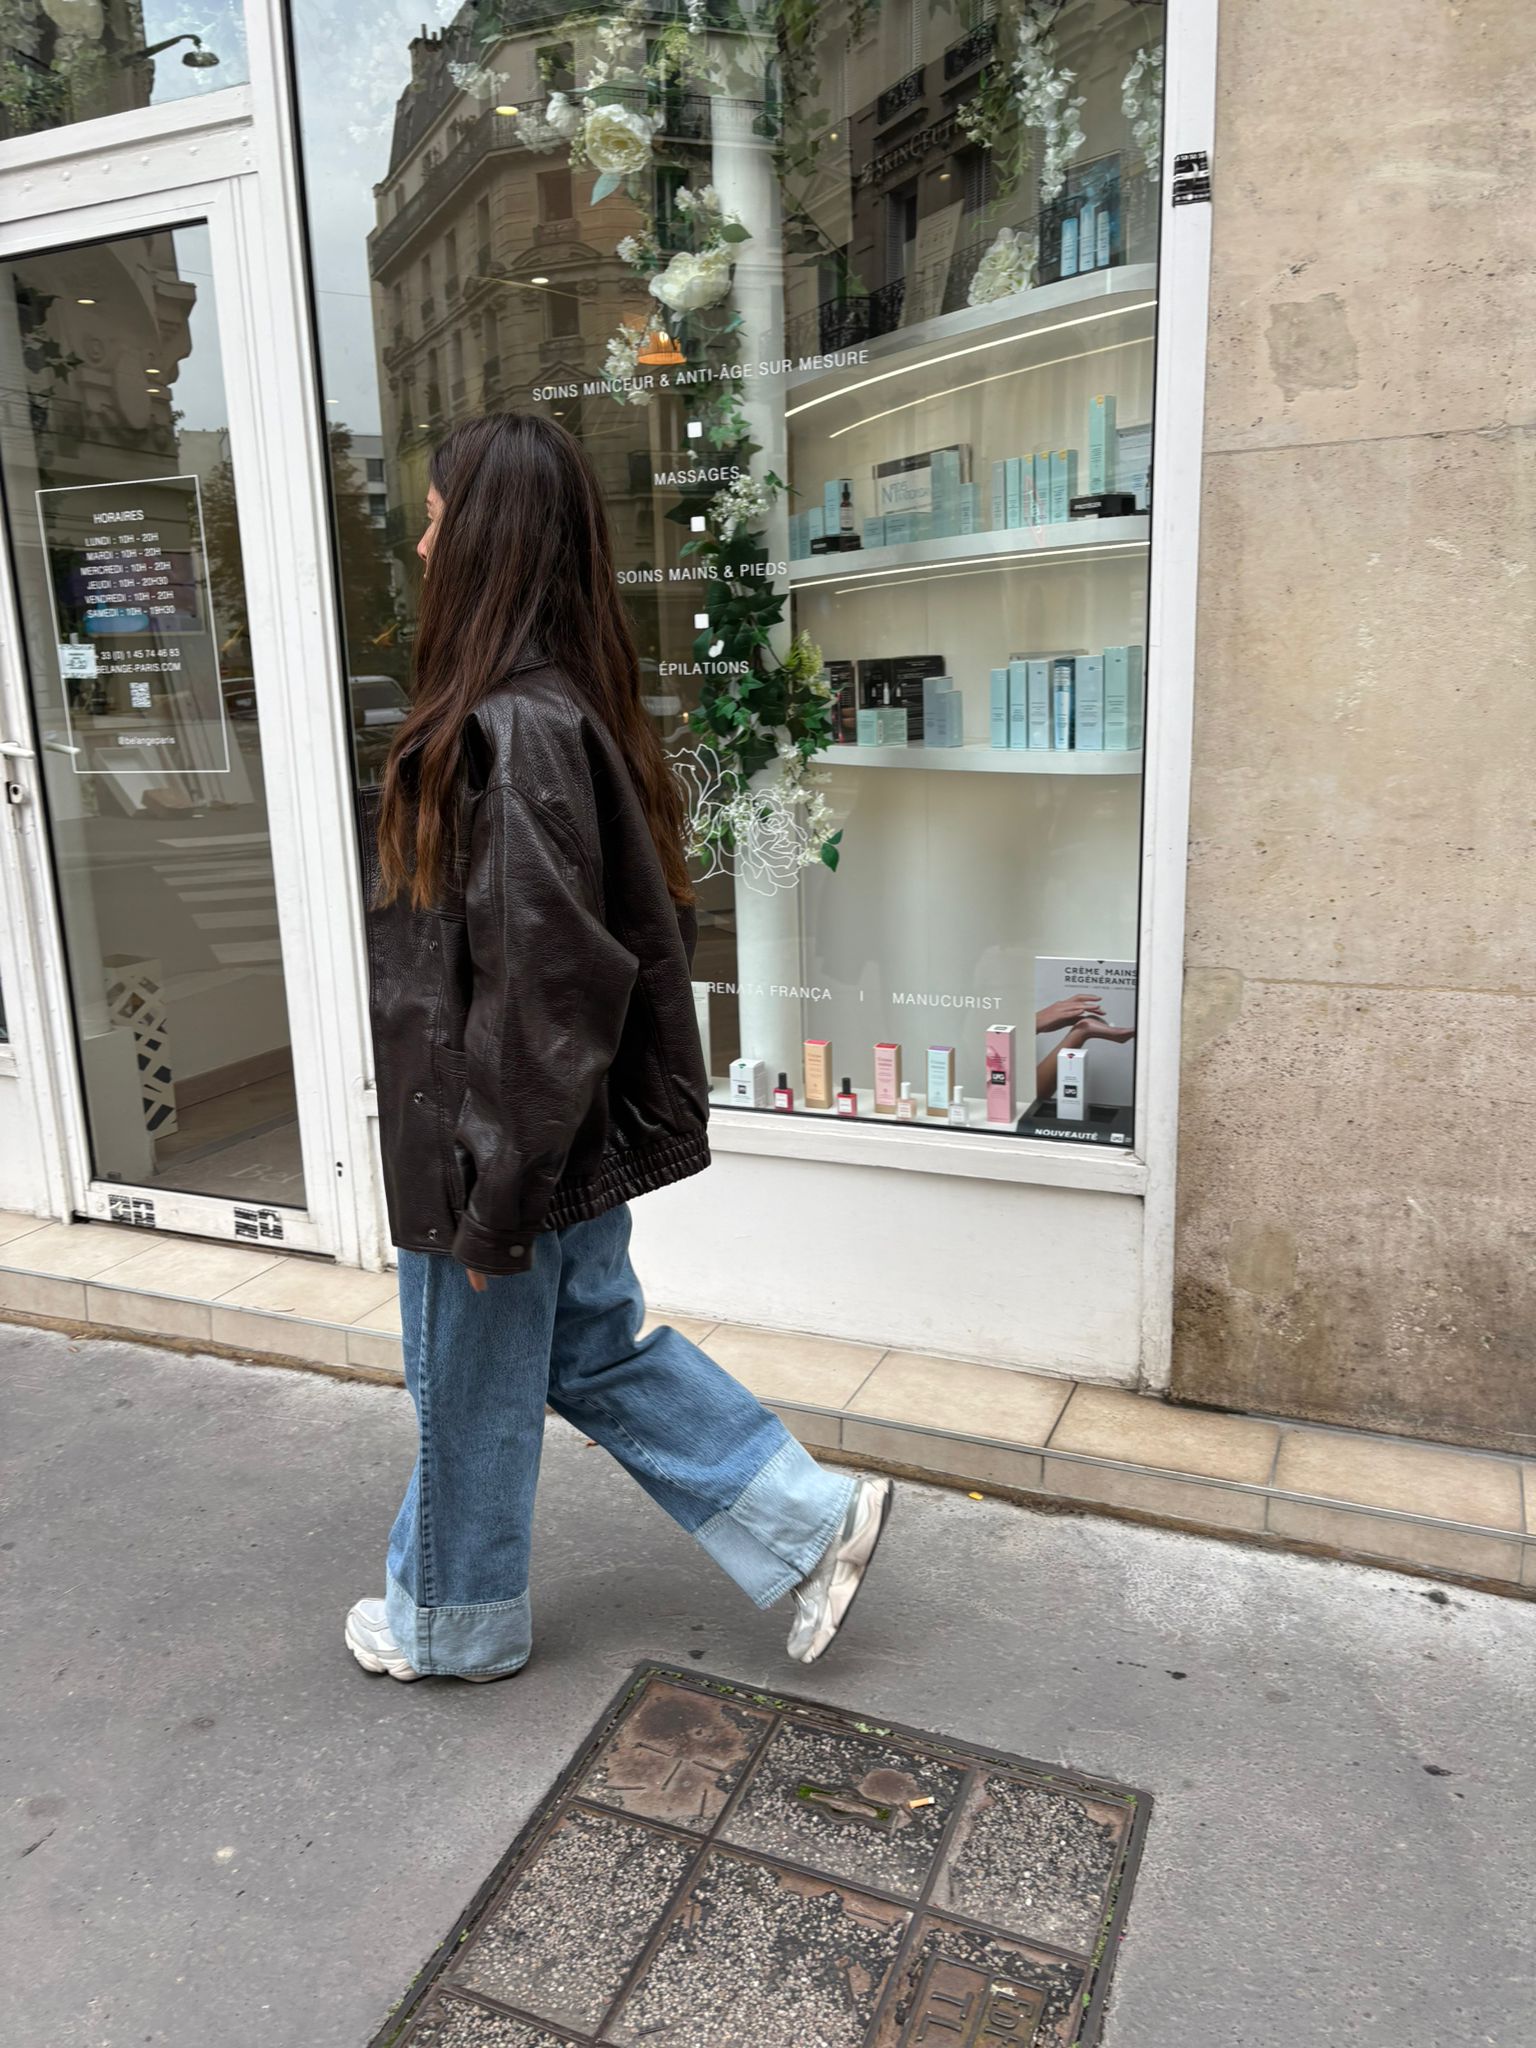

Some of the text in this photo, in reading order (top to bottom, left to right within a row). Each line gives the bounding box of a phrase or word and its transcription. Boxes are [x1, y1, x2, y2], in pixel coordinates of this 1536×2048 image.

[532, 349, 869, 401] SOINS MINCEUR & ANTI-ÂGE SUR MESURE
[654, 465, 741, 486] MASSAGES
[93, 509, 145, 524] HORAIRES
[84, 536, 111, 547] LUNDI
[86, 550, 114, 561] MARDI
[80, 564, 123, 576] MERCREDI
[616, 561, 788, 585] SOINS MAINS & PIEDS
[84, 593, 127, 604] VENDREDI
[658, 660, 750, 676] ÉPILATIONS
[1064, 965, 1137, 977] CRÈME MAINS
[1064, 975, 1137, 986] RÉGÉNÉRANTE
[707, 981, 764, 997] RENATA
[769, 985, 832, 1002] FRANÇA
[892, 992, 1002, 1010] MANUCURIST
[1034, 1128, 1099, 1141] NOUVEAUTÉ
